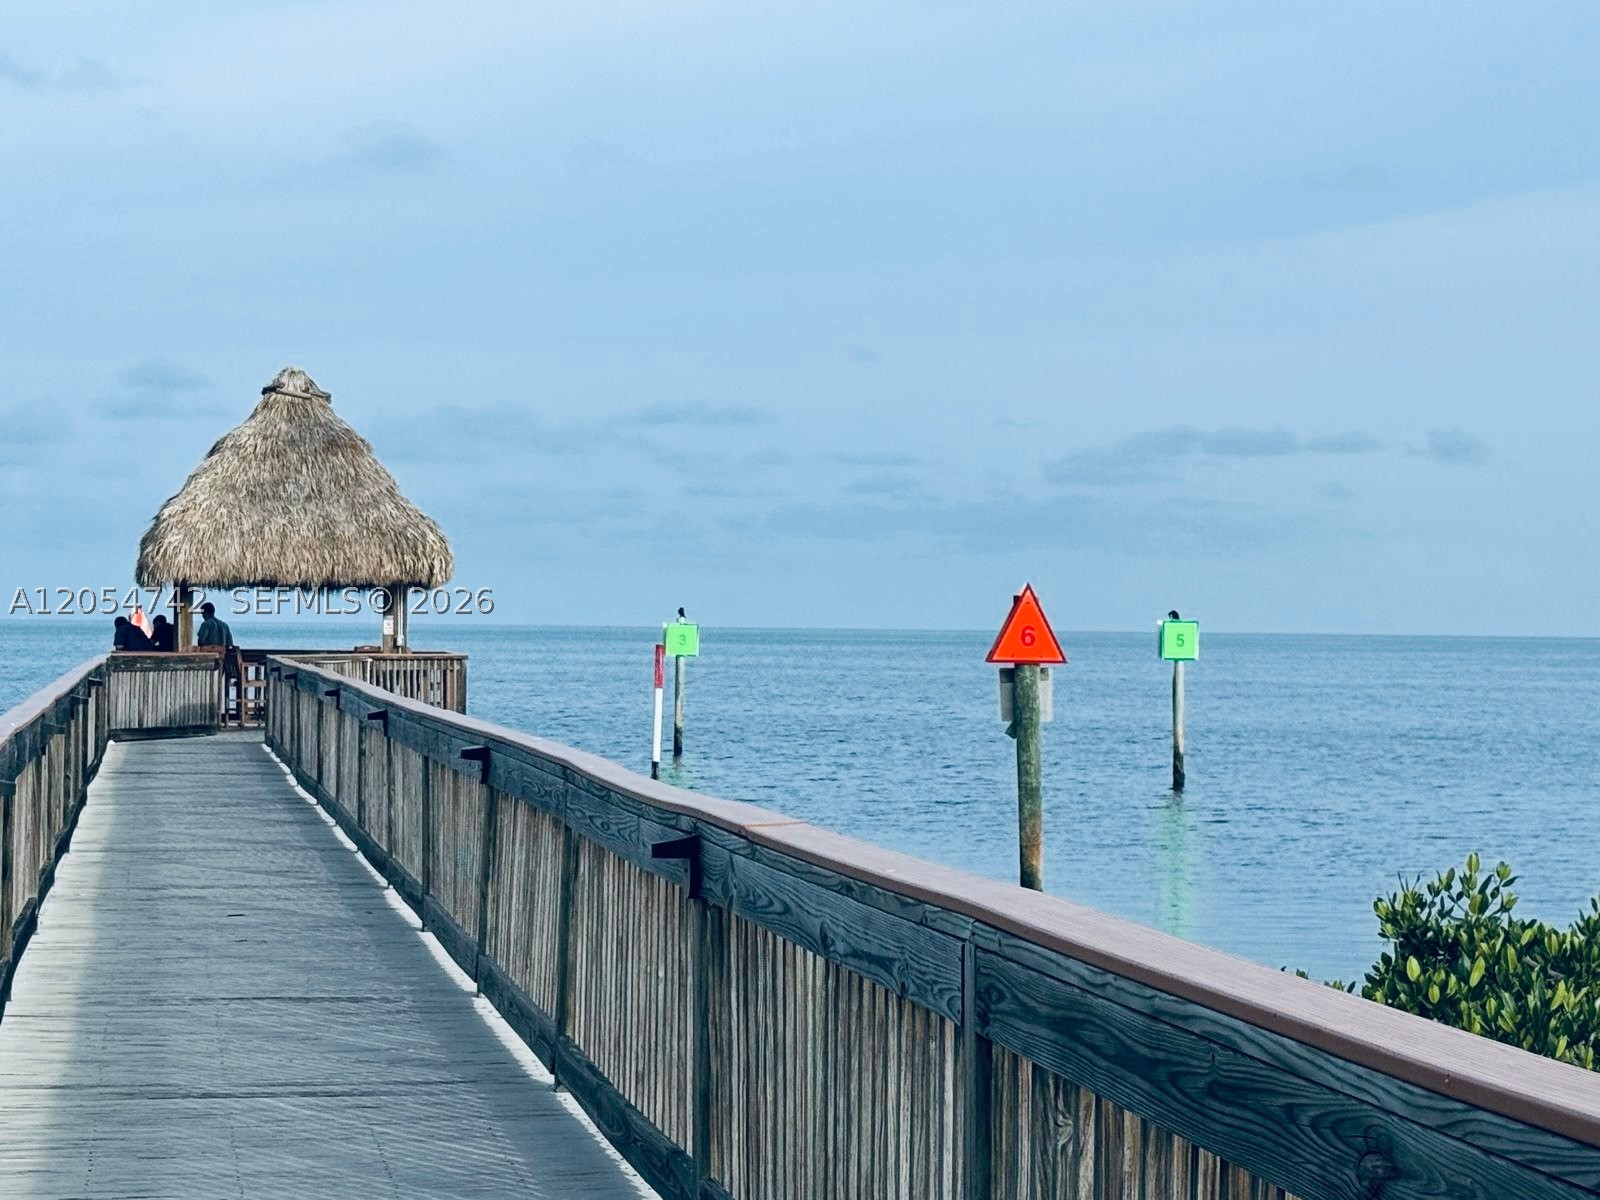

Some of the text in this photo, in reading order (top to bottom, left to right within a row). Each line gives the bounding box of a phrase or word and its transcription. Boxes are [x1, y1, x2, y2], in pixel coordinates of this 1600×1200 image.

[678, 634, 687, 646] 3
[1020, 625, 1036, 647] 6
[1176, 633, 1185, 648] 5
